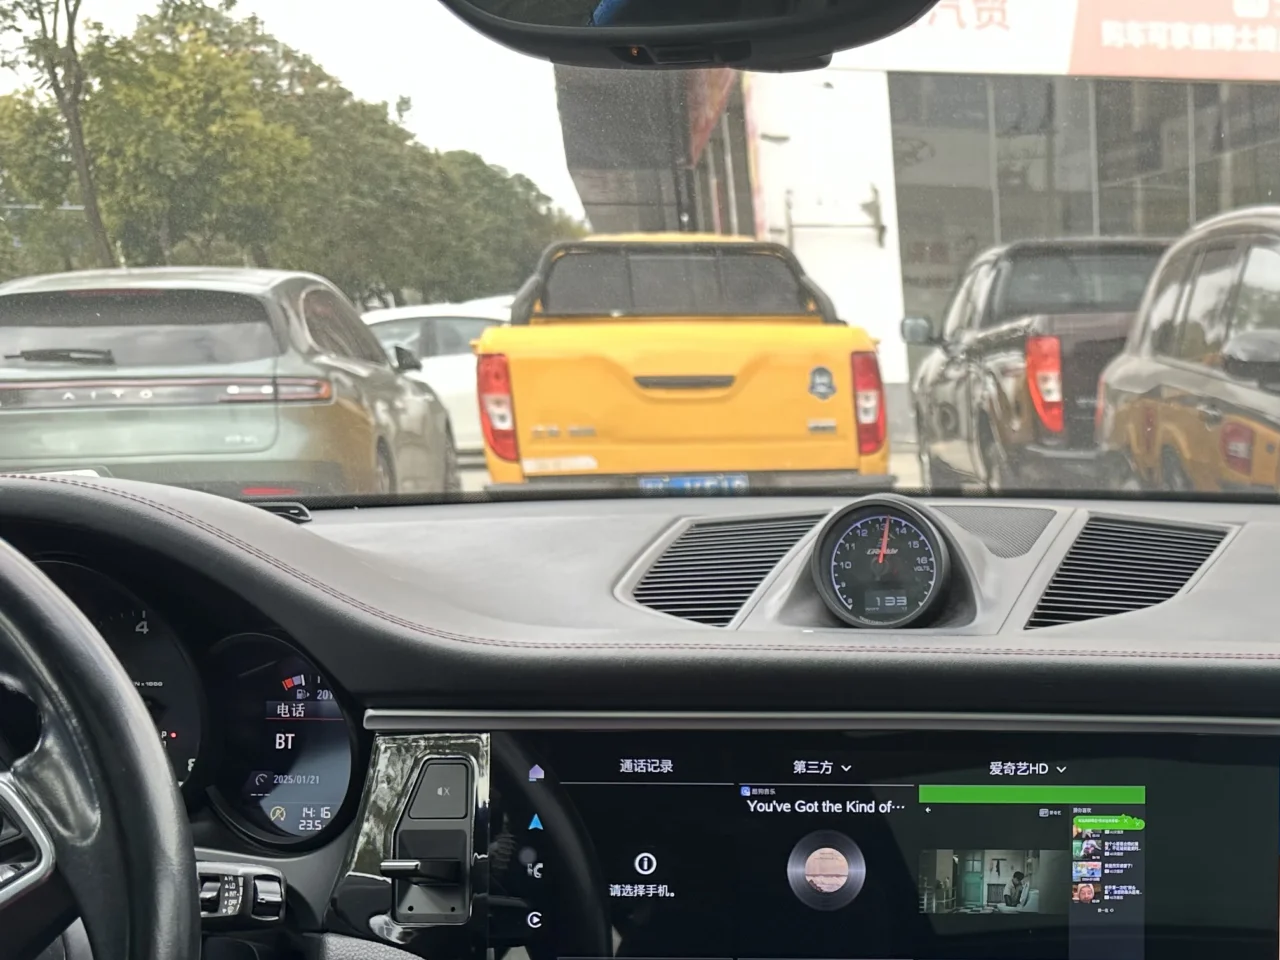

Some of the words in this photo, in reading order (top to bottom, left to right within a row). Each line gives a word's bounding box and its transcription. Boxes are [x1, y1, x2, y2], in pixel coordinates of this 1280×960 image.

[856, 529, 868, 537] 12
[845, 543, 855, 551] 11
[840, 561, 851, 569] 10
[135, 620, 149, 634] 4
[277, 703, 305, 718] 电话
[275, 734, 295, 750] BT
[620, 759, 673, 774] 通话记录
[793, 760, 834, 775] 第三方
[989, 762, 1048, 776] 爱奇艺HD
[274, 774, 320, 785] 2025/01/21
[303, 807, 331, 818] 14:16
[747, 800, 791, 813] You've
[795, 800, 818, 813] Got
[822, 800, 842, 813] the
[847, 801, 875, 814] Kind
[609, 884, 676, 898] 请选择手机。
